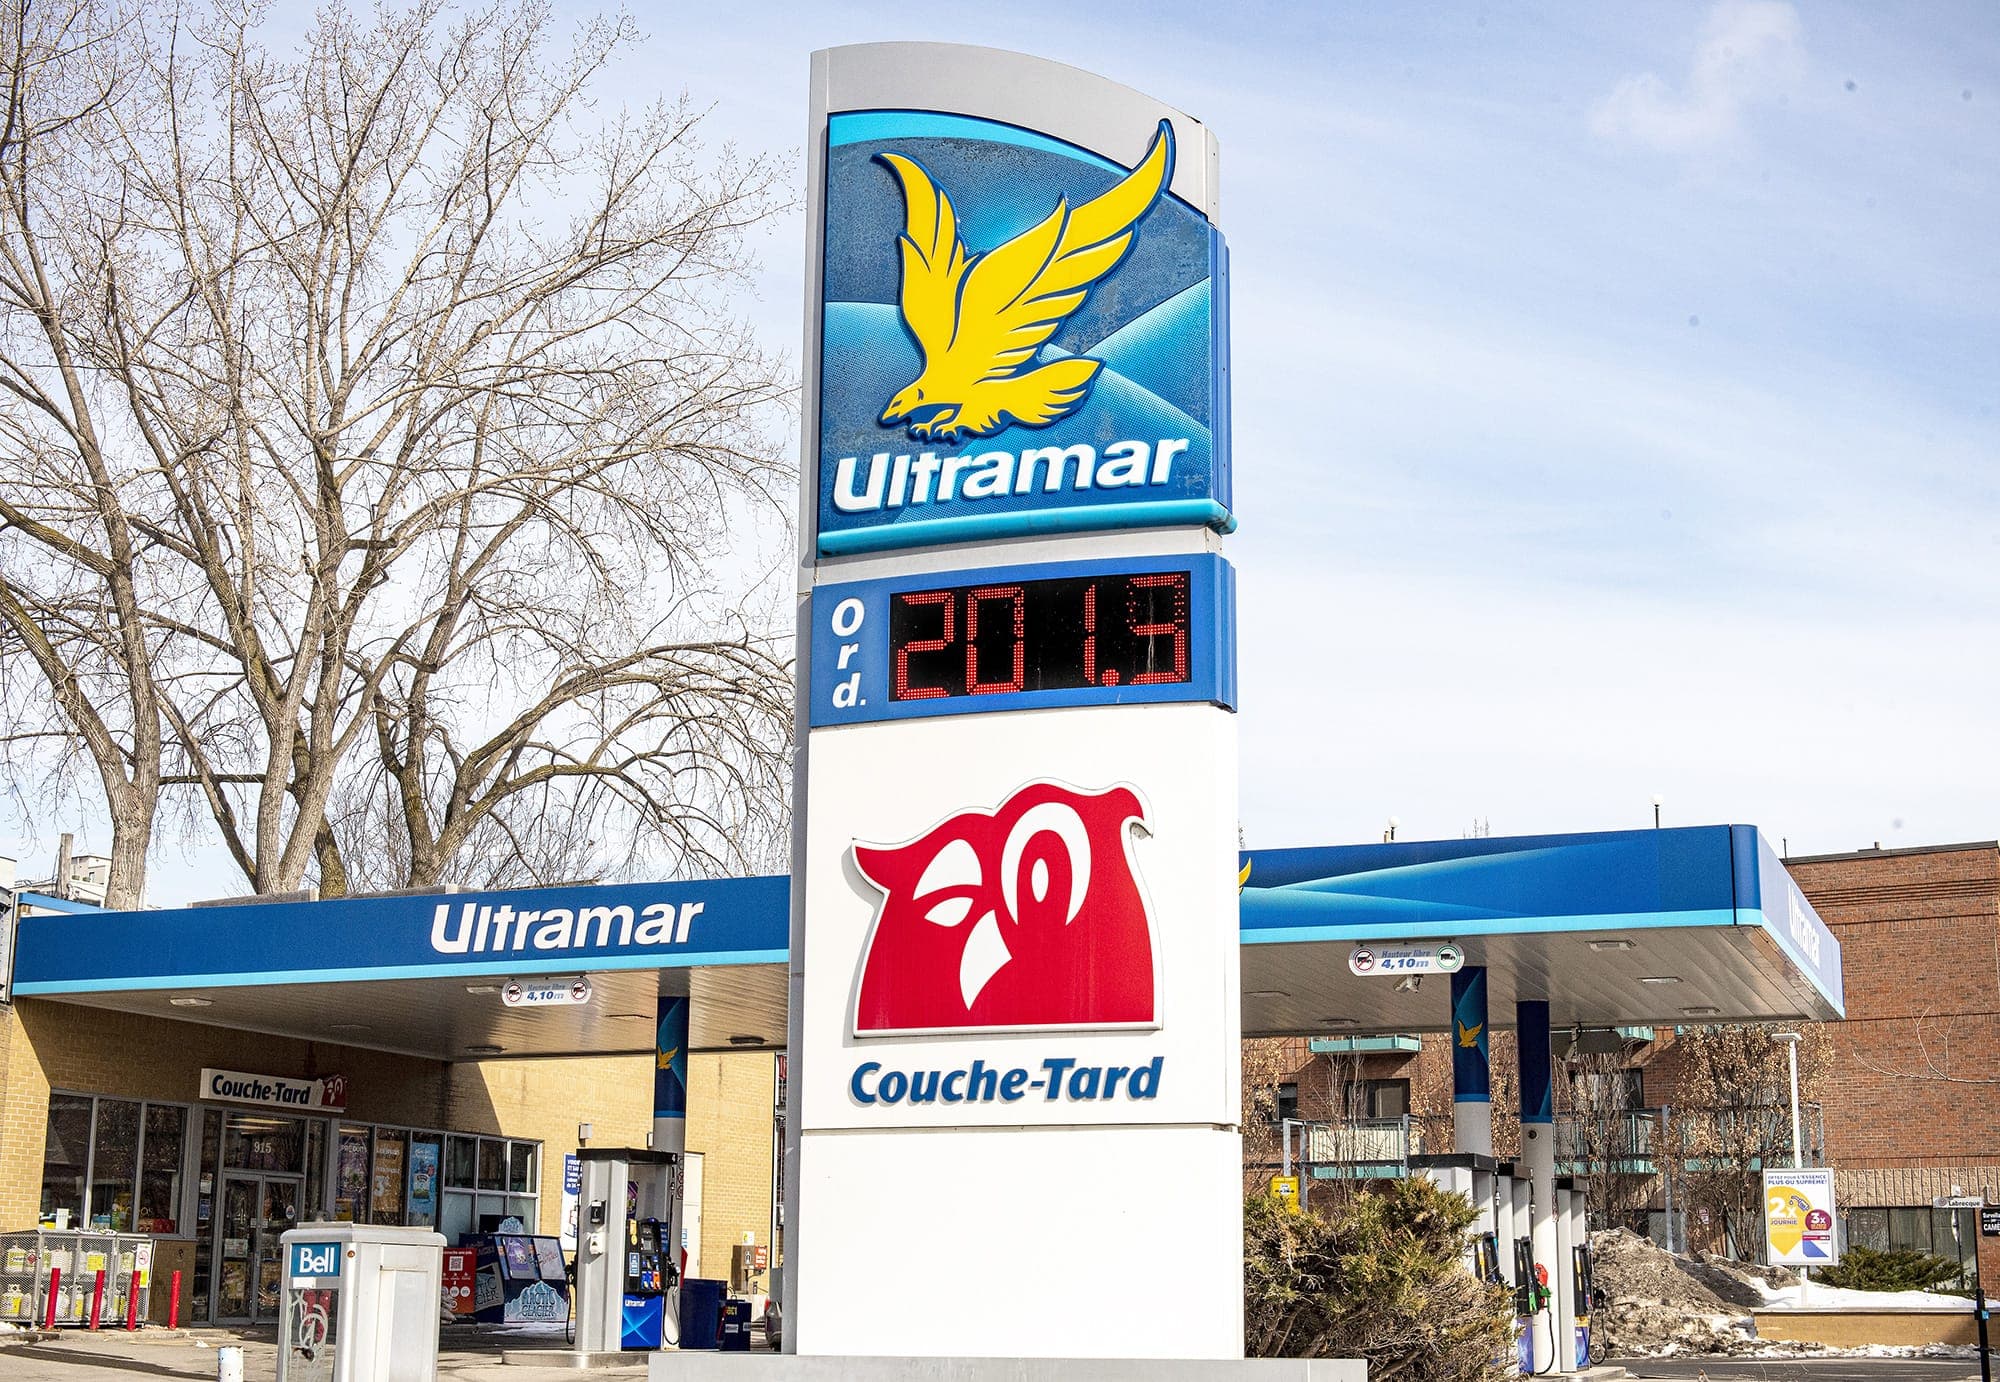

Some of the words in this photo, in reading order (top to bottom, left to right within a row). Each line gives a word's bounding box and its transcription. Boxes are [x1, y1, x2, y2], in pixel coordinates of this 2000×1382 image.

[833, 437, 1190, 514] Ultramar
[897, 573, 1186, 701] 201.9
[430, 902, 705, 954] Ultramar
[212, 1074, 311, 1105] Couche-Tard
[850, 1056, 1164, 1104] Couche-Tard
[254, 1142, 272, 1154] 915
[1810, 1212, 1826, 1224] 3x
[300, 1247, 335, 1273] Bell
